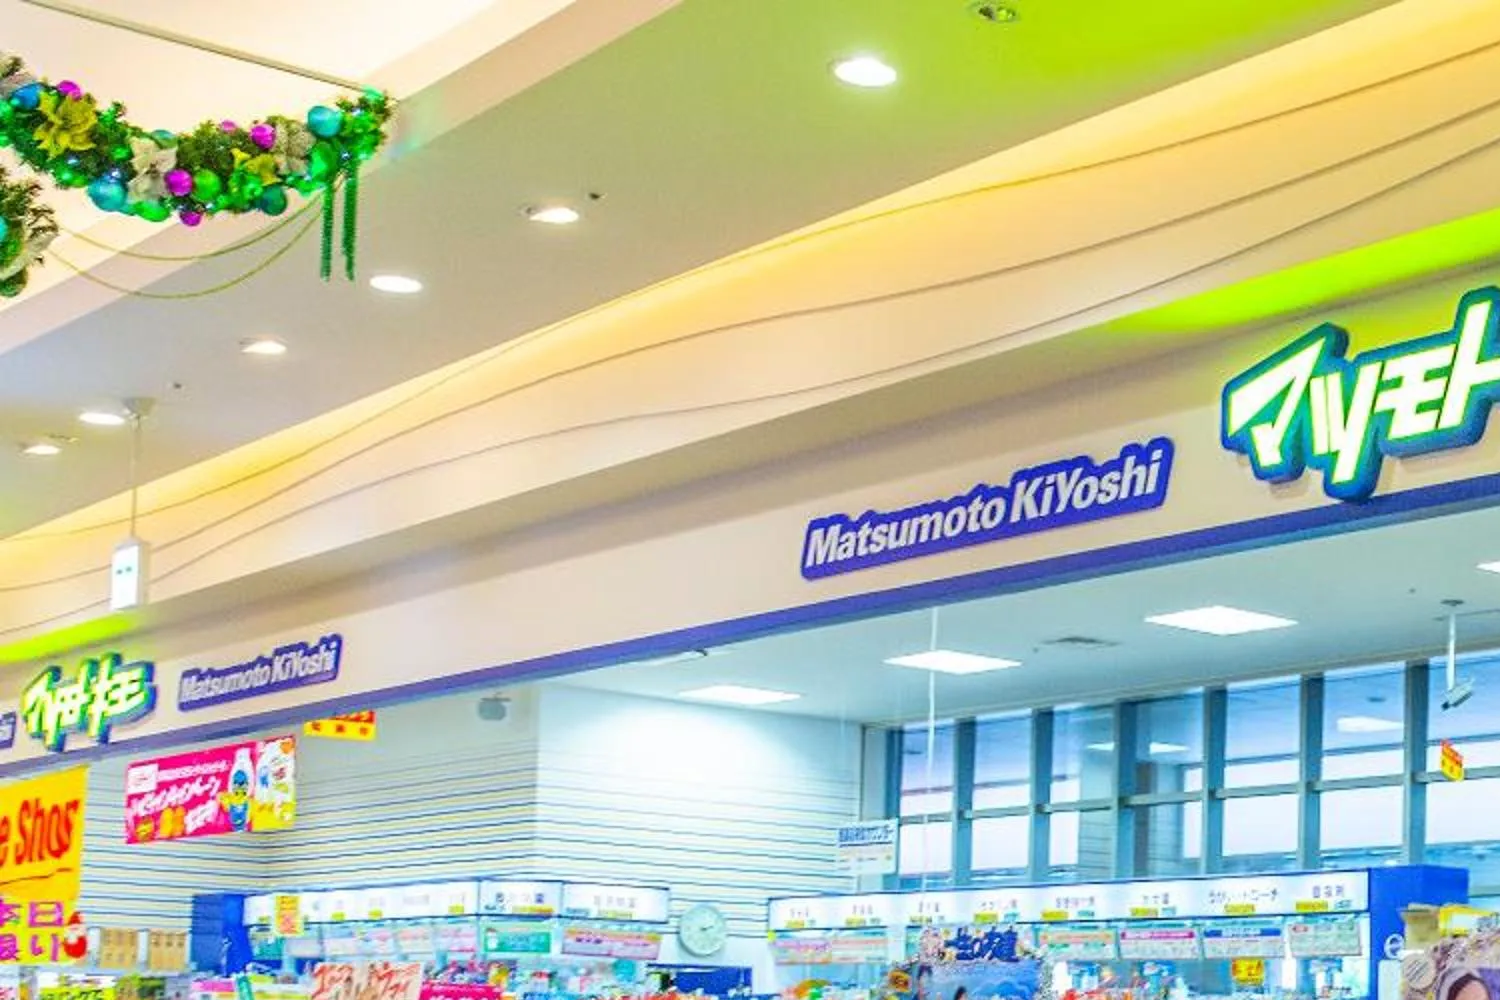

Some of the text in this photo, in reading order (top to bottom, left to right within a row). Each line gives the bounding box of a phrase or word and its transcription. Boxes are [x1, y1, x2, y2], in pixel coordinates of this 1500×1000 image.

[805, 449, 1163, 568] Matsumoto KiYoshi
[180, 641, 337, 702] Matsumoto KiYoshi
